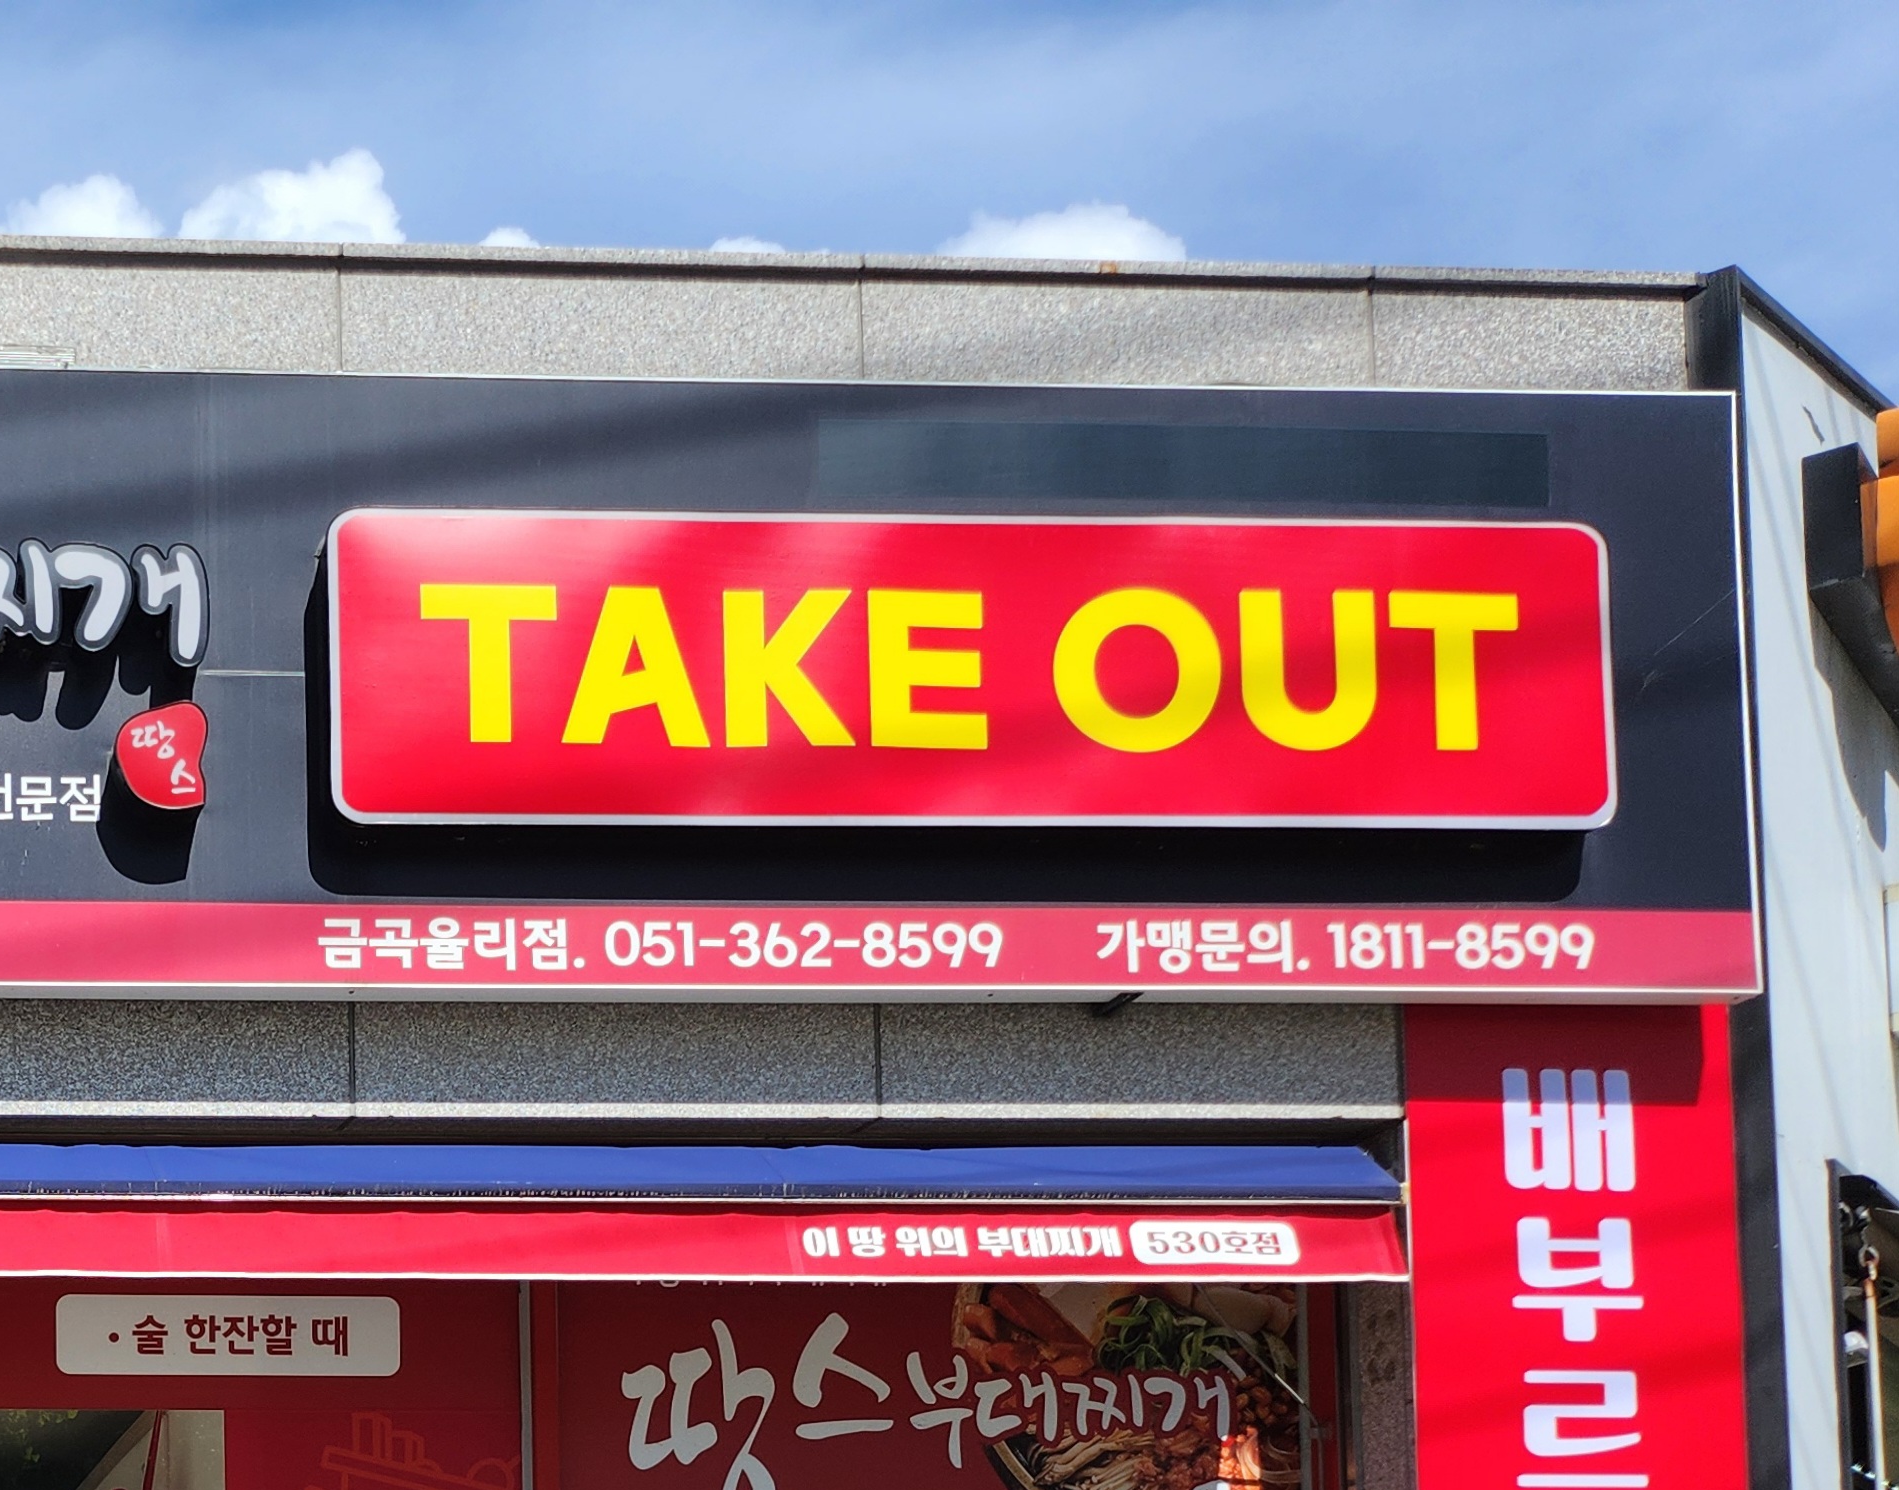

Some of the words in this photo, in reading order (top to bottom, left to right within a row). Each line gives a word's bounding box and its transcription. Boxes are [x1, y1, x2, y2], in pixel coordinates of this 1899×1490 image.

[419, 583, 989, 750] TAKE
[1052, 587, 1520, 752] OUT
[129, 725, 197, 795] 땅스
[316, 918, 587, 973] 금곡율리점.
[604, 920, 1004, 971] 051-362-8599
[1097, 920, 1310, 973] 가맹문의.
[1326, 922, 1596, 971] 1811-8599
[802, 1225, 840, 1258] 이
[847, 1226, 887, 1258] 땅
[895, 1226, 967, 1258] 위의
[977, 1225, 1123, 1260] 부대찌개
[1145, 1226, 1283, 1258] 530호점
[130, 1315, 169, 1358] 술
[182, 1315, 297, 1358] 한잔할
[311, 1315, 350, 1358] 때
